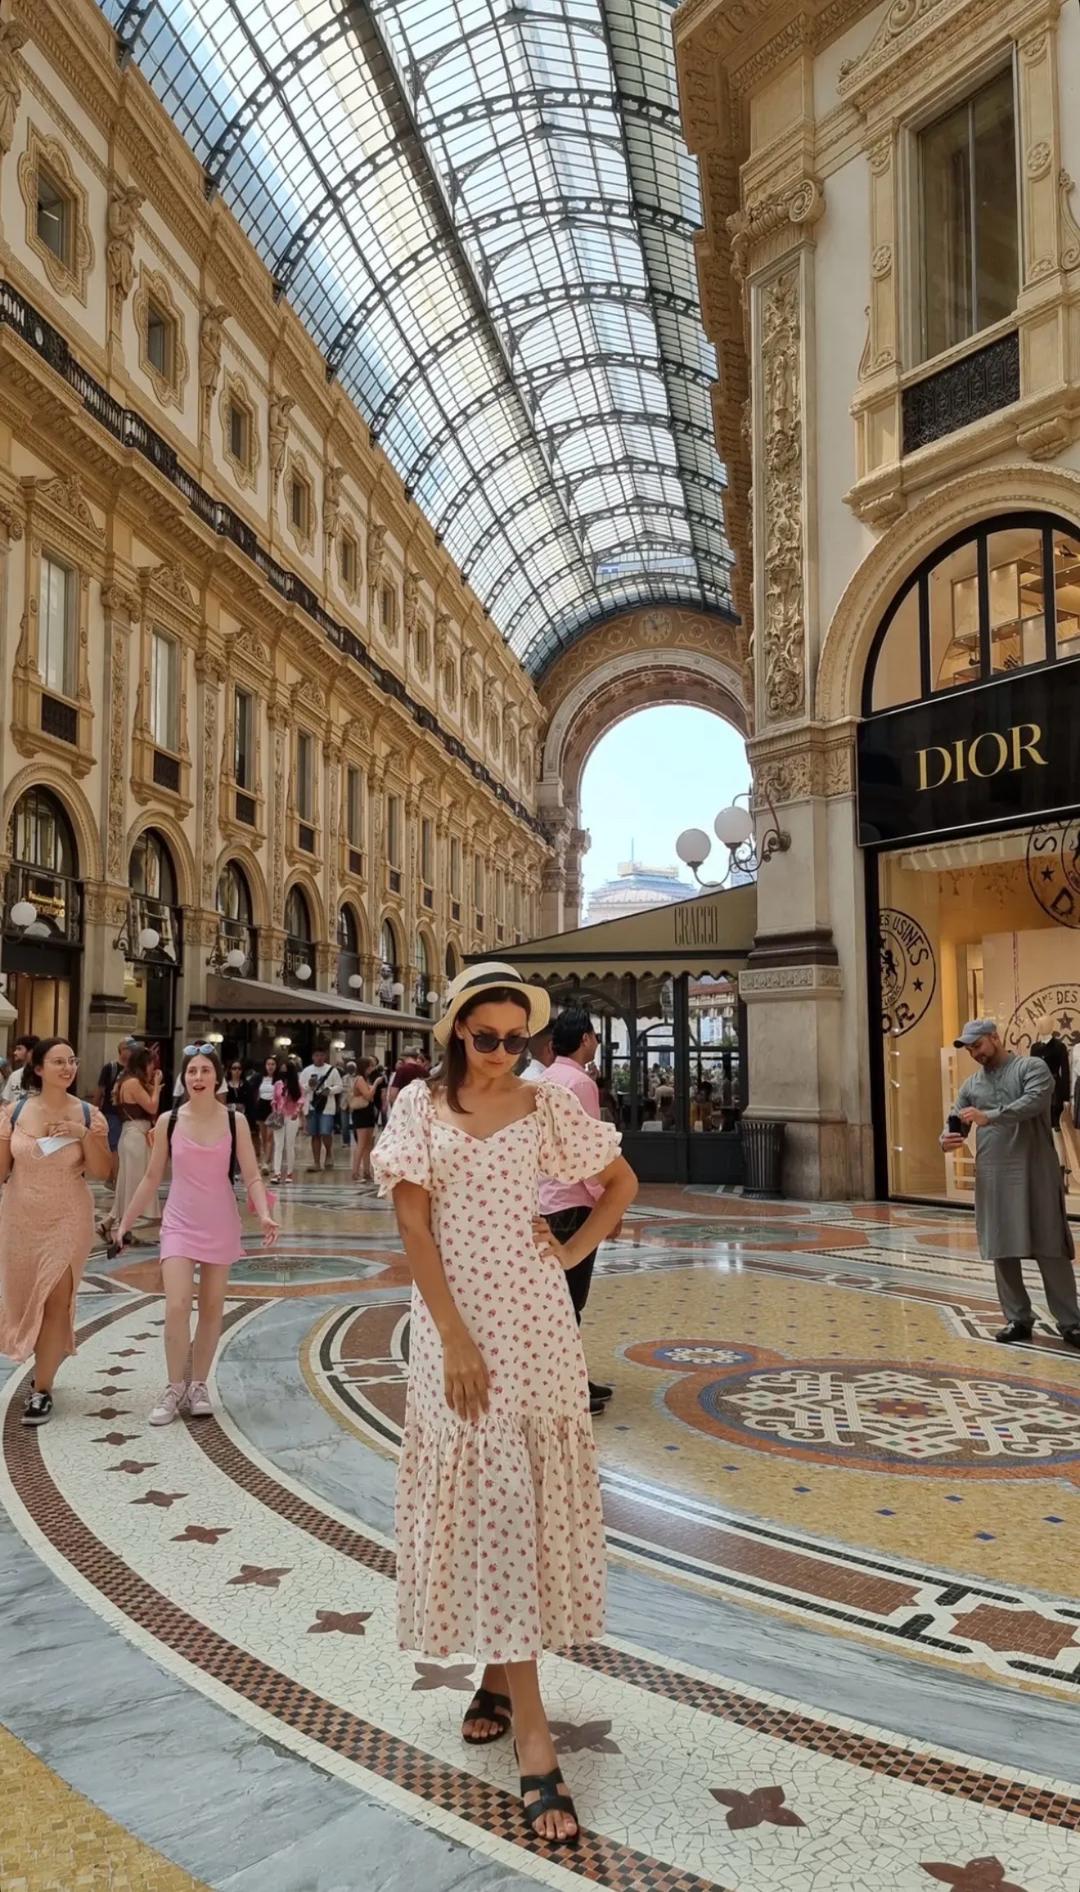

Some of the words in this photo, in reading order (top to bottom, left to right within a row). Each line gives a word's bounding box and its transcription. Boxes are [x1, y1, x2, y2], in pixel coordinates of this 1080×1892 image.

[914, 723, 1049, 792] DIOR
[673, 905, 719, 946] CRACCO
[892, 916, 929, 966] USINES
[1056, 990, 1079, 1006] DES
